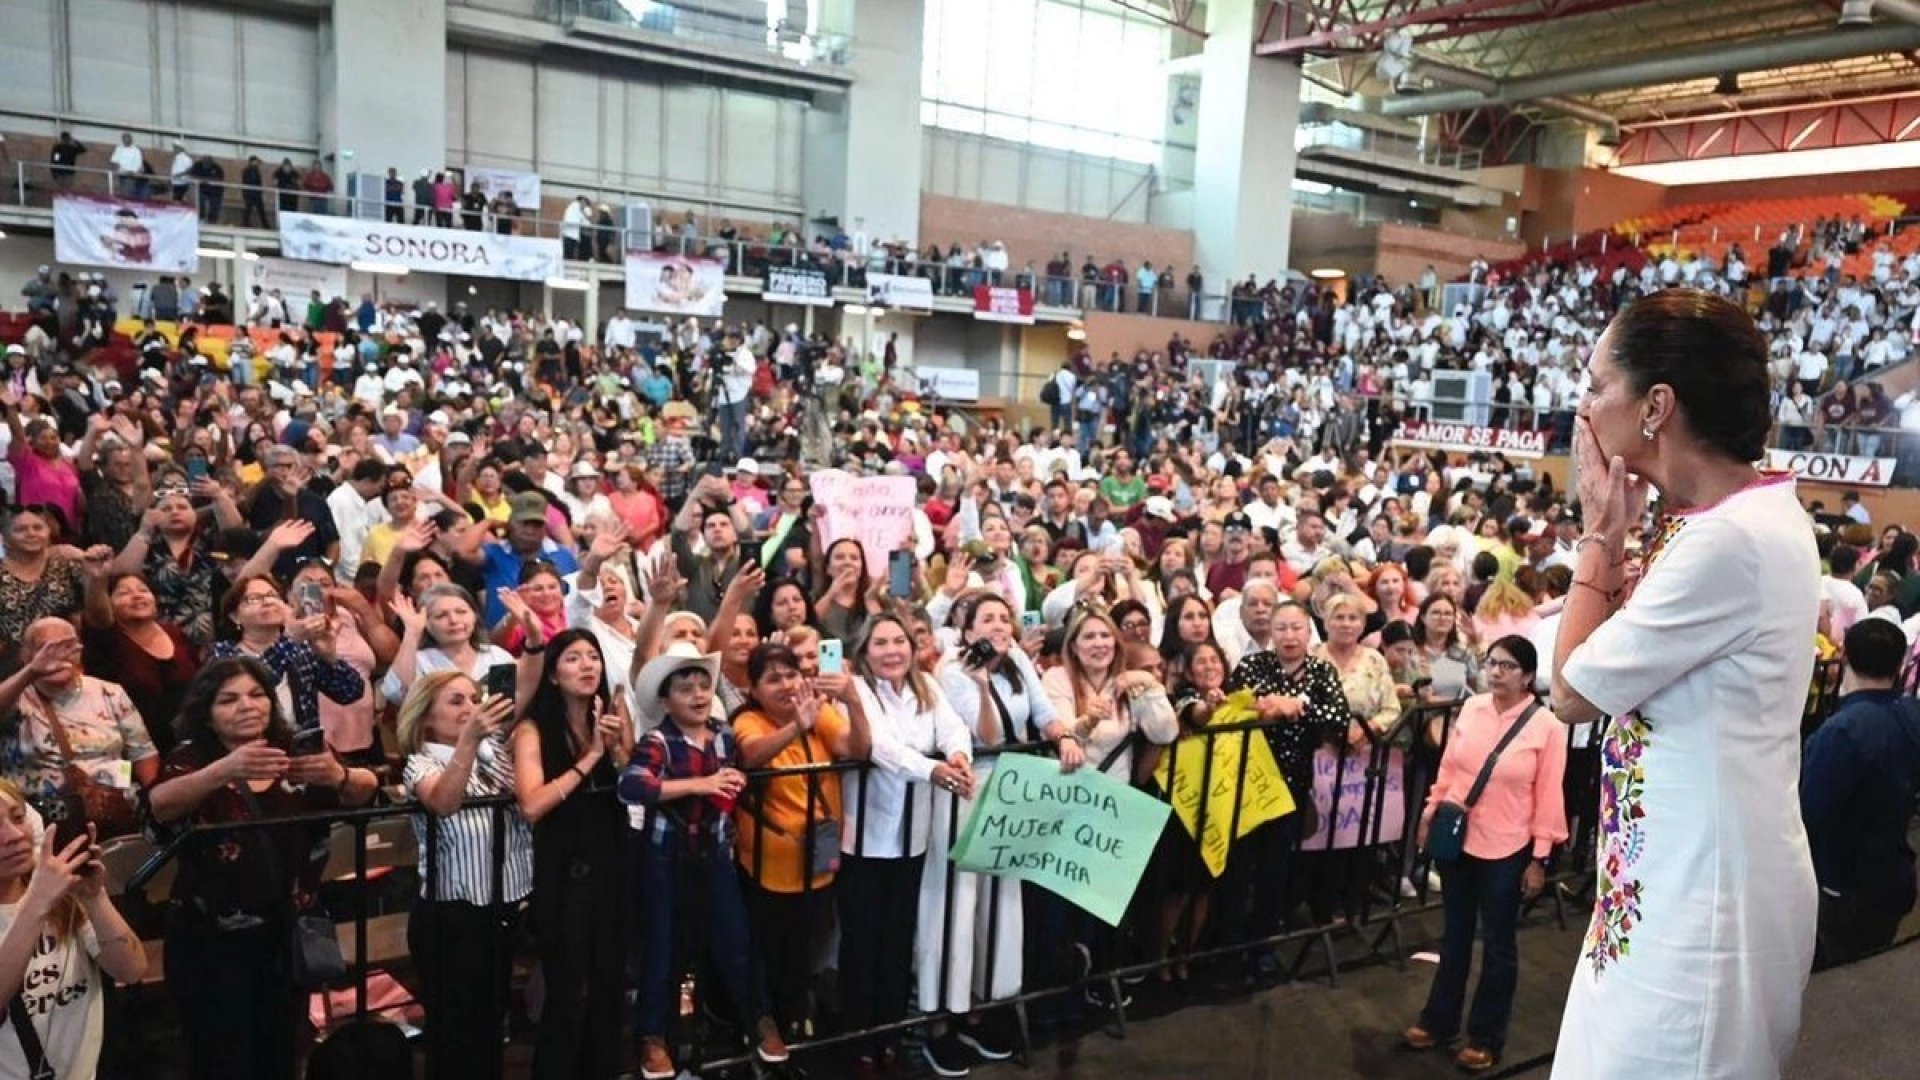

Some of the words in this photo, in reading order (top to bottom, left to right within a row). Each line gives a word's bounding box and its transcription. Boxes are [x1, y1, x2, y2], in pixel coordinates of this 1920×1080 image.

[366, 233, 490, 265] SONORA
[1468, 426, 1492, 446] SE
[1495, 428, 1545, 452] PAGA
[1787, 453, 1850, 479] CON
[1859, 458, 1882, 482] A
[997, 769, 1119, 819] CLAUDIA
[980, 814, 1065, 839] MUJER
[1074, 823, 1126, 859] QUE
[985, 844, 1091, 886] INSPIRA
